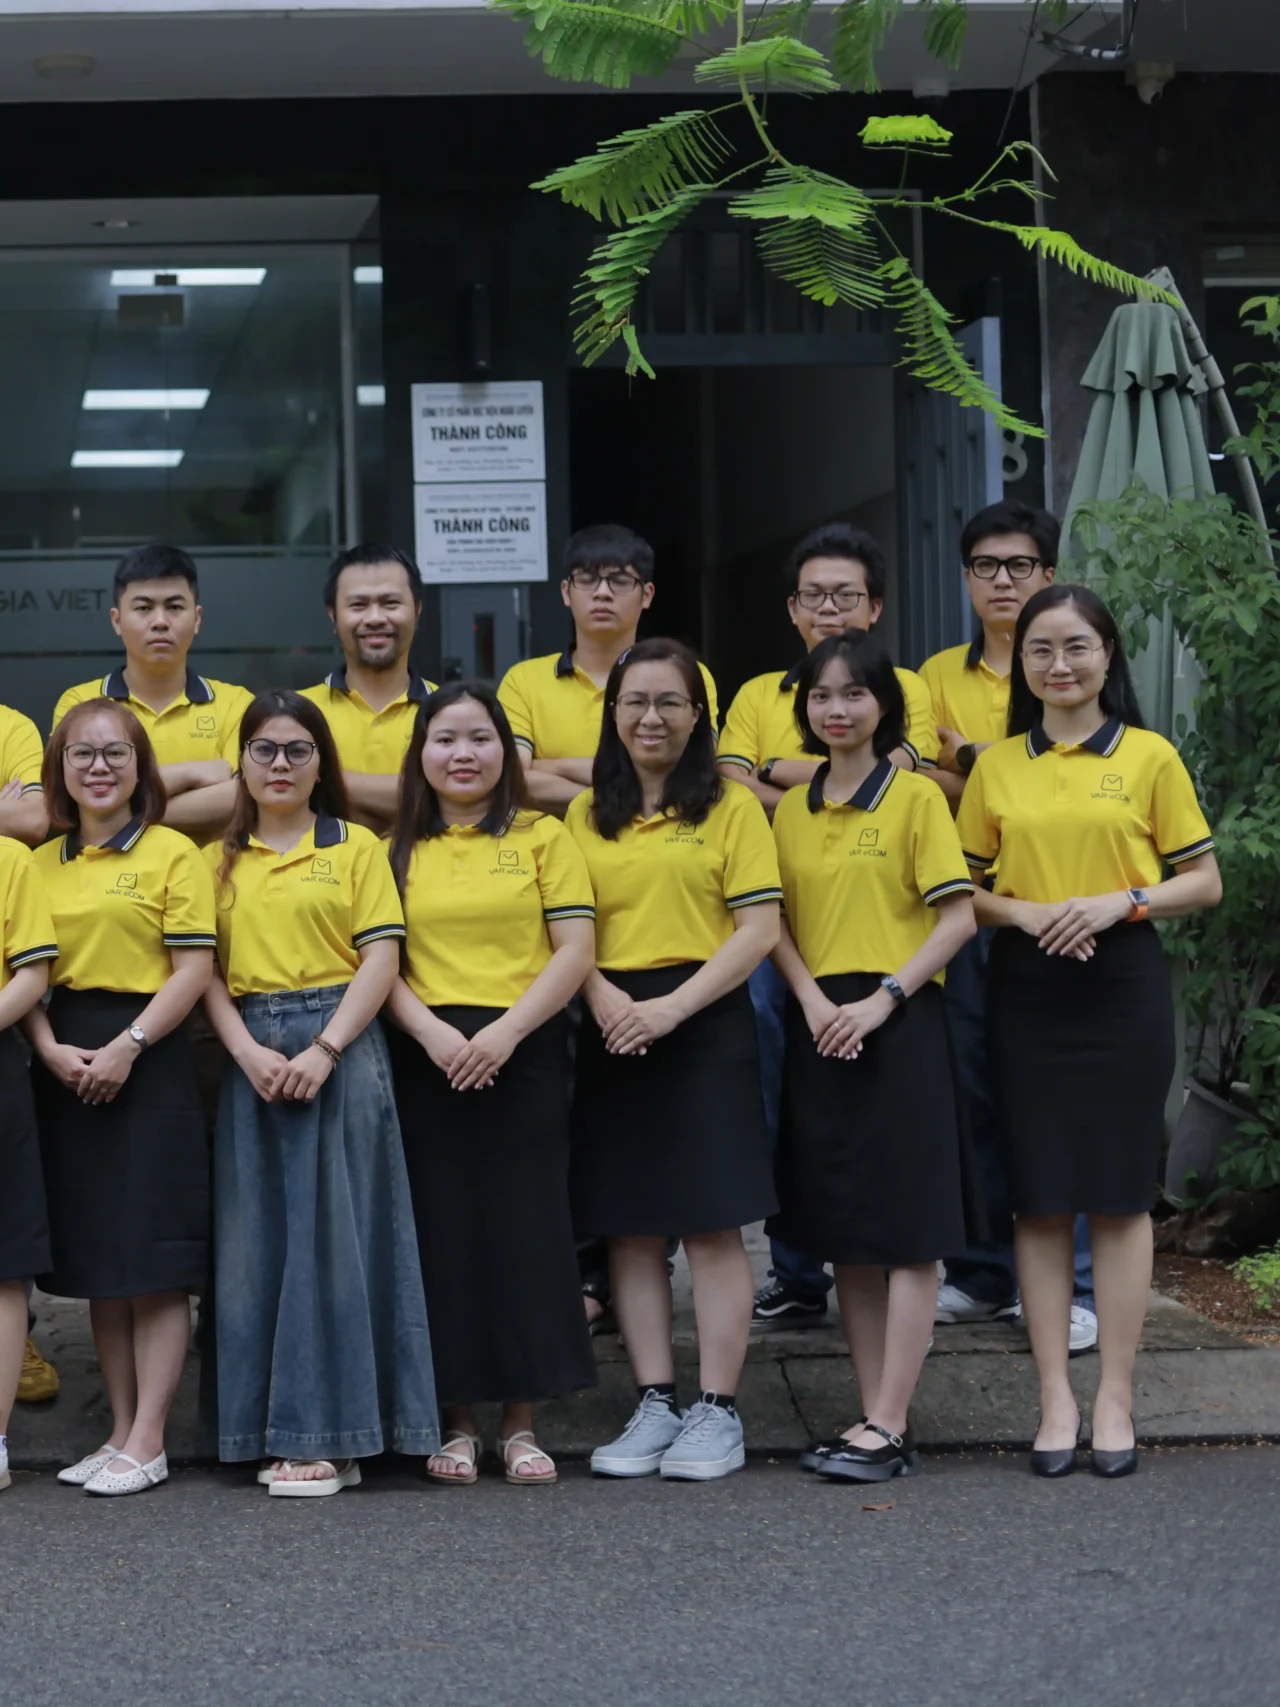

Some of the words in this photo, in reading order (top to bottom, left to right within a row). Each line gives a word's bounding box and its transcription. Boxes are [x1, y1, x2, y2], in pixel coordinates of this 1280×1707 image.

[430, 422, 480, 441] THÀNH
[486, 422, 527, 440] CÔNG
[433, 515, 483, 534] THÀNH
[489, 514, 531, 533] CÔNG
[46, 588, 107, 612] VIET
